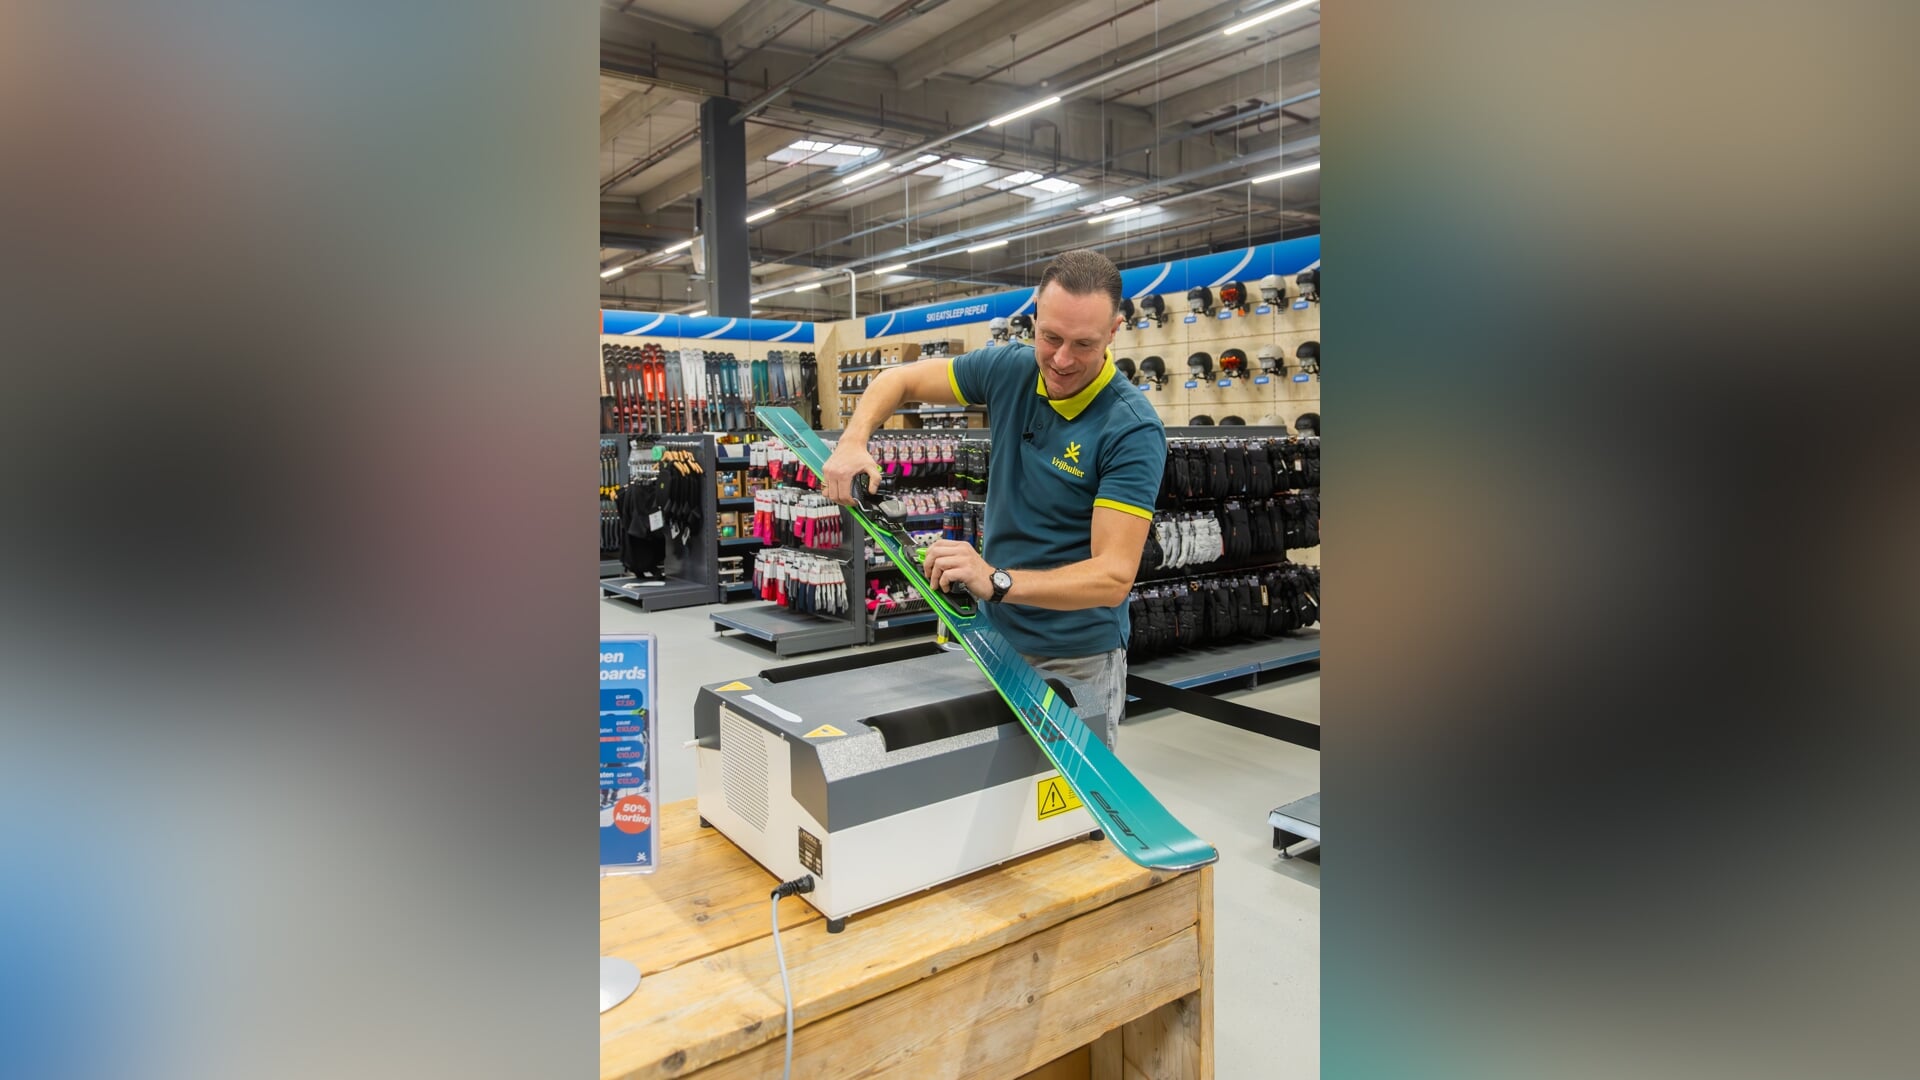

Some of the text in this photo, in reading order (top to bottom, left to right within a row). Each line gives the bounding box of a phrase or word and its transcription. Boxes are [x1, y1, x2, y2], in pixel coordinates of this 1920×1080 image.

[926, 312, 936, 322] SKI
[946, 308, 964, 319] SLEEP
[964, 304, 988, 316] REPEAT
[1052, 456, 1084, 478] Vrijbuiter
[622, 803, 646, 814] 50%
[616, 812, 651, 824] korting
[1090, 790, 1150, 850] elan
